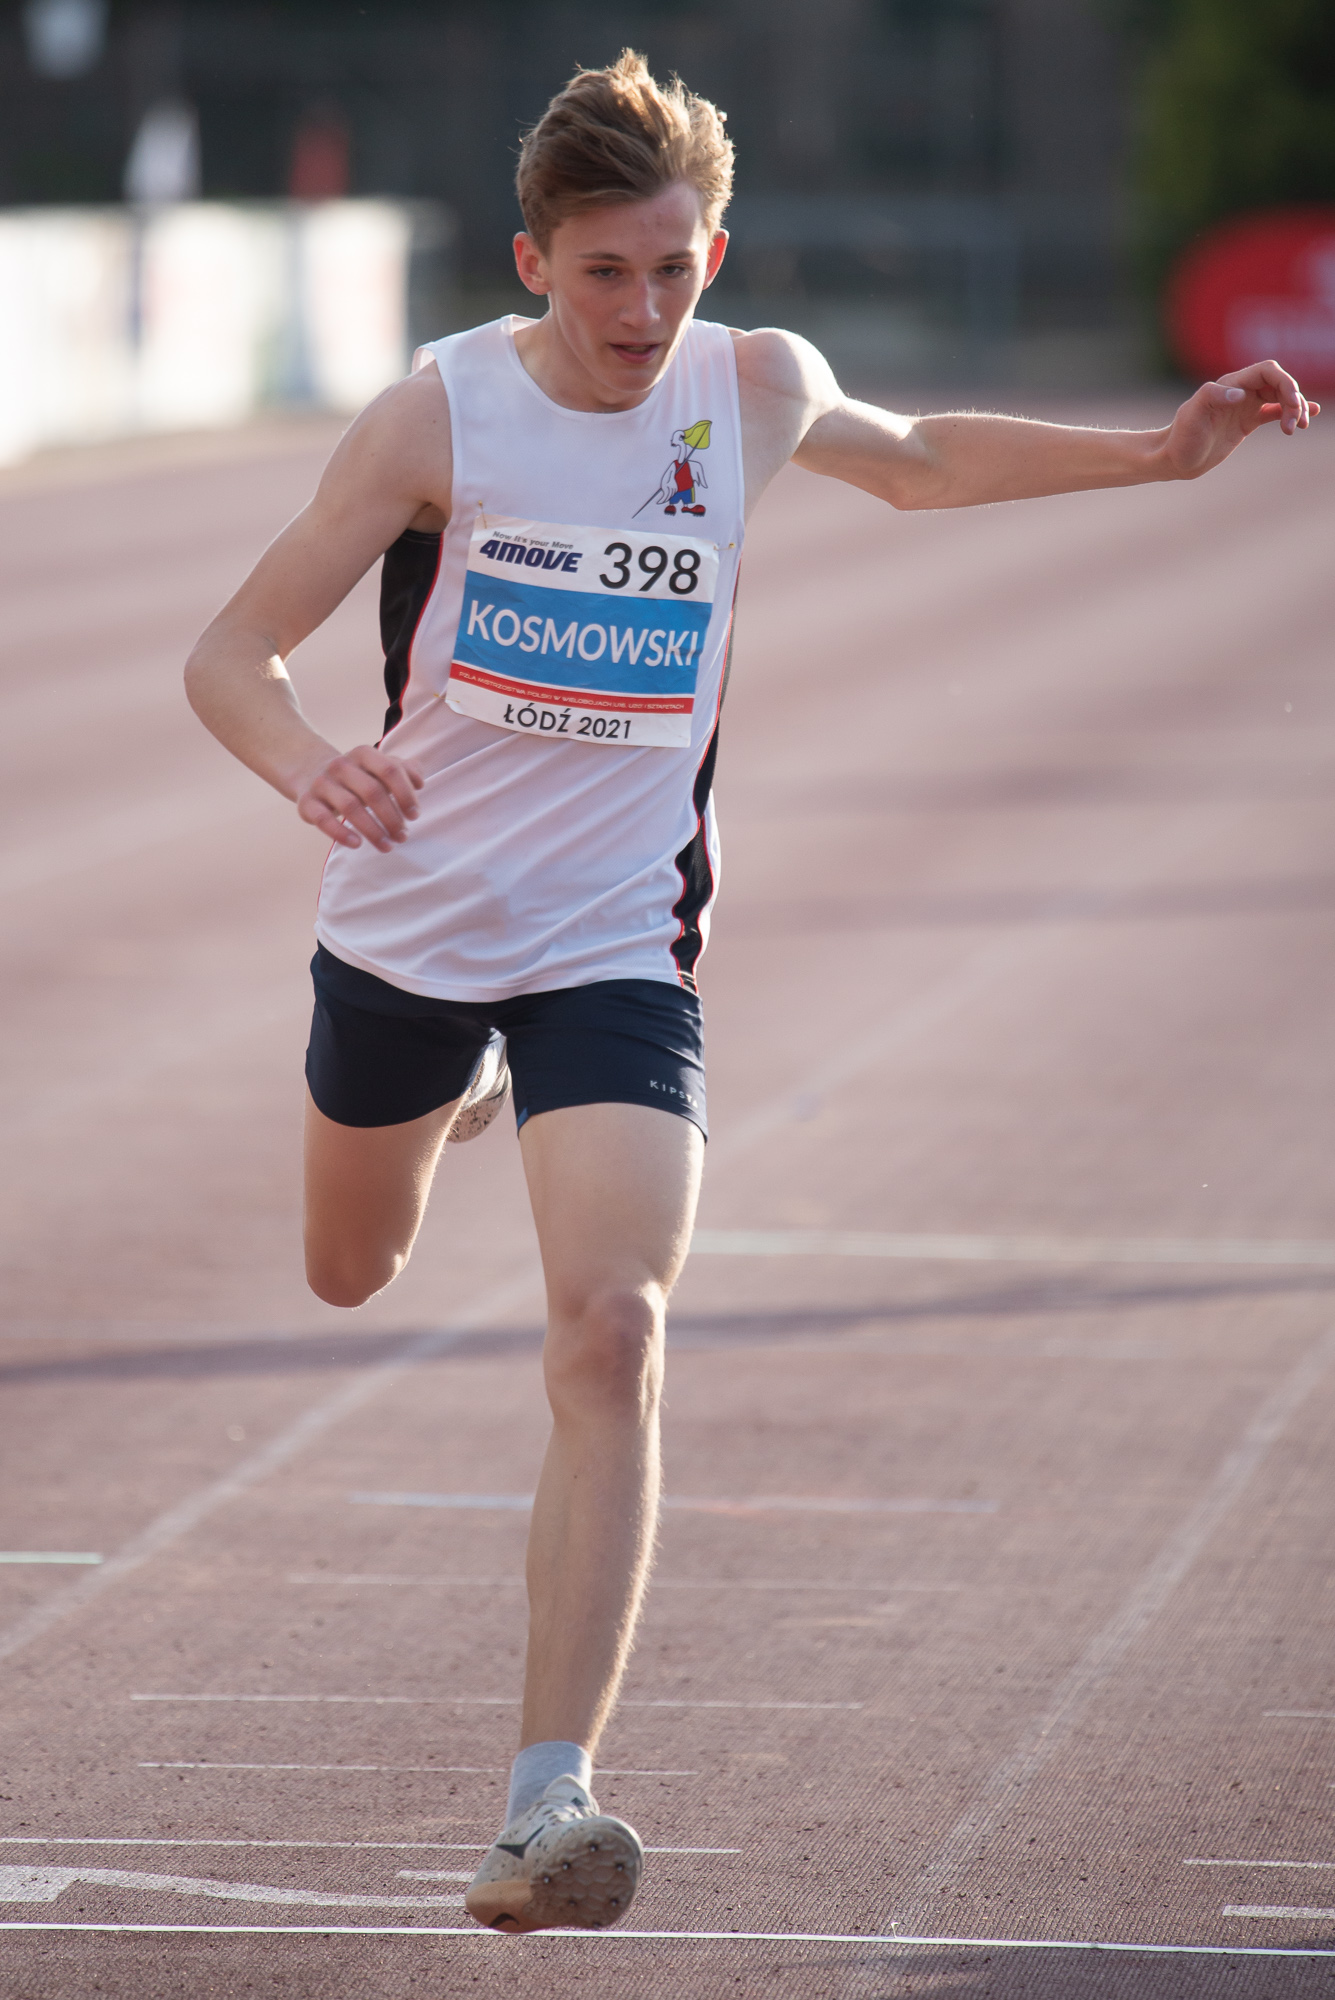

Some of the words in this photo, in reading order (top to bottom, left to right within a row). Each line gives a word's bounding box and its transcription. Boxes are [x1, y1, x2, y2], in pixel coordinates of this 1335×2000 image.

[479, 539, 583, 573] 4MOVE
[492, 531, 513, 540] Now
[529, 539, 550, 547] your
[551, 541, 574, 550] Move
[599, 541, 702, 595] 398
[466, 599, 699, 667] KOSMOWSKI
[477, 677, 526, 695] MISTRZOSTWA
[527, 690, 552, 700] POLSKI
[563, 697, 612, 707] WIELOBOJACH
[503, 702, 571, 733] ŁÓDŹ
[576, 715, 631, 739] 2021
[649, 1080, 689, 1109] KIPSTA
